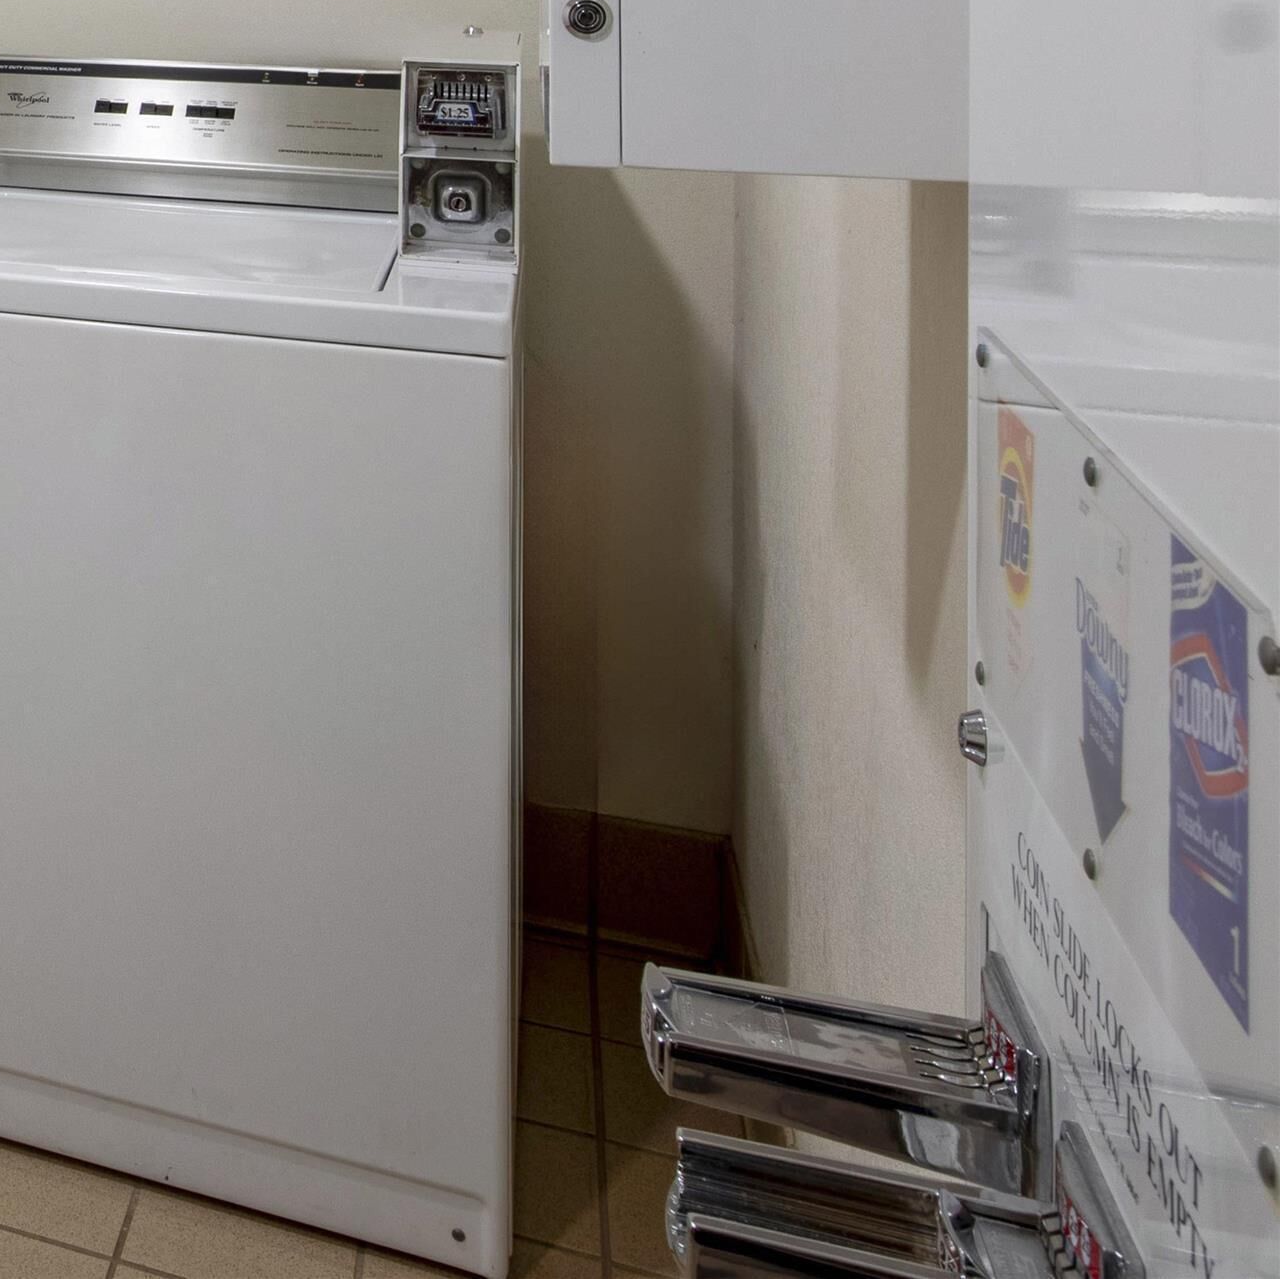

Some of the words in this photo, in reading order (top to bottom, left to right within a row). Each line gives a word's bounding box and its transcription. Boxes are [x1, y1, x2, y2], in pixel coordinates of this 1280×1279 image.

[8, 91, 50, 107] Whirlpool
[440, 107, 469, 118] $1.25
[999, 473, 1031, 576] Tide
[1074, 576, 1129, 704] Downy
[1172, 668, 1238, 762] CLOROX
[1012, 863, 1050, 969] WHEN
[1053, 953, 1120, 1114] COLUMN
[1126, 1092, 1140, 1153] IS
[1147, 1132, 1216, 1279] EMPTY
[1017, 831, 1050, 916] COIN
[1053, 897, 1091, 1000] SLIDE
[1096, 978, 1152, 1118] LOCKS
[1159, 1102, 1203, 1211] OUT
